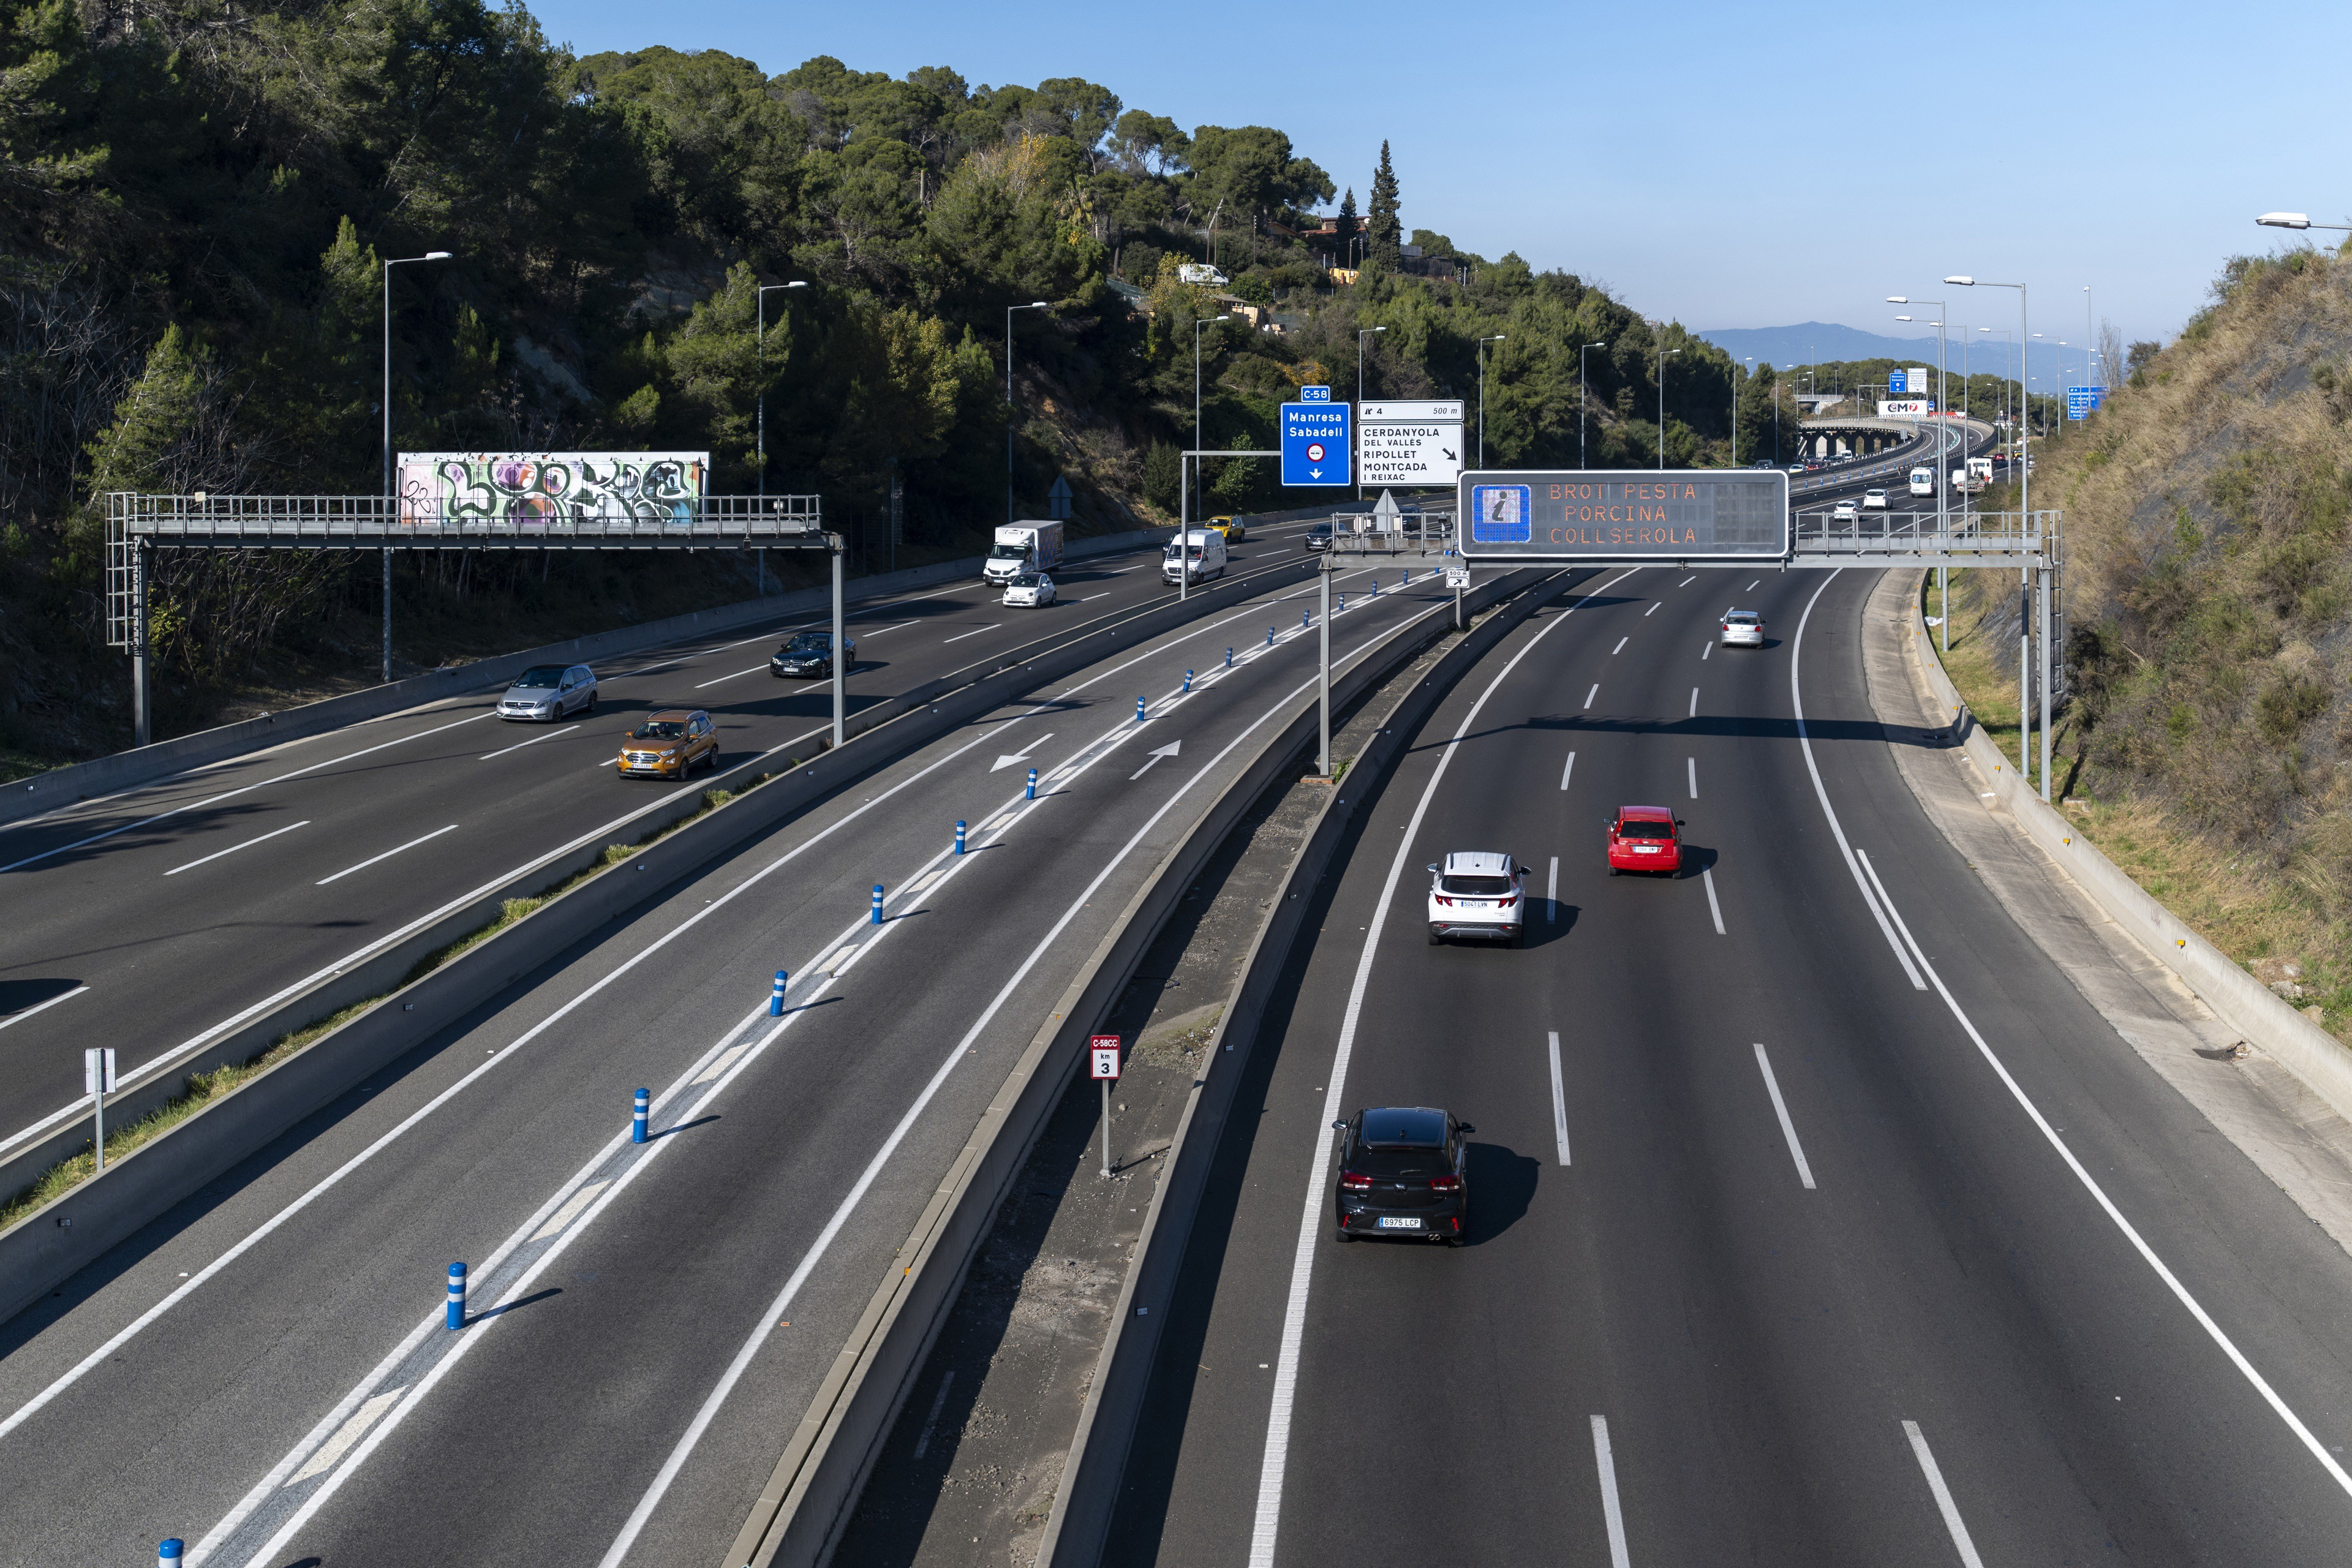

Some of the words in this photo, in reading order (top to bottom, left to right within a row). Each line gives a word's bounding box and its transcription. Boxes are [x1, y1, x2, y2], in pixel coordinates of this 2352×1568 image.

[1304, 390, 1327, 399] C-58
[1289, 412, 1341, 422] Manresa
[1289, 427, 1343, 437] Sabadell
[1550, 484, 1604, 499] BROT
[1624, 484, 1695, 499] PESTA
[1565, 505, 1666, 521] PORCINA
[1550, 527, 1696, 543] COLLSEROLA
[1101, 1063, 1110, 1074] 3
